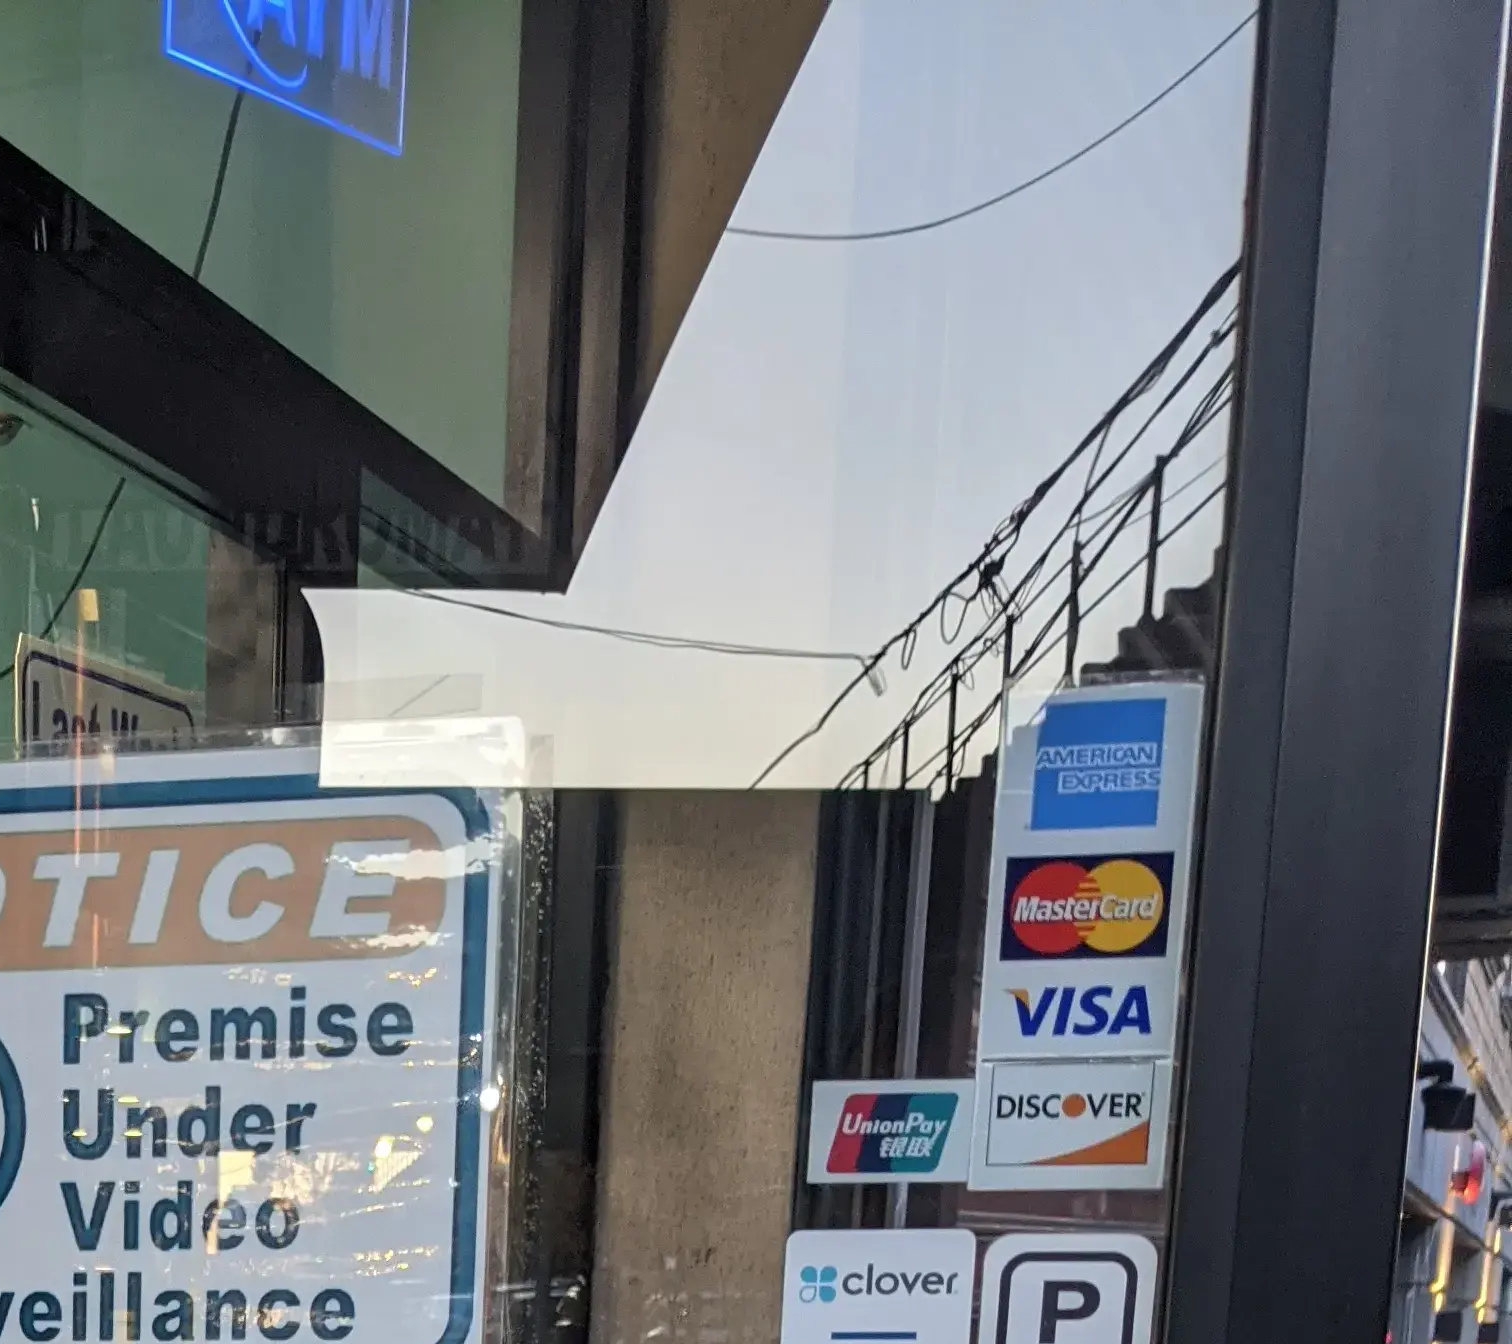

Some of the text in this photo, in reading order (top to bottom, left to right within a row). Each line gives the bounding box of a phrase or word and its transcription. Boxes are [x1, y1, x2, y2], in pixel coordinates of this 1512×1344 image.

[1036, 744, 1155, 766] AMERICAN
[1059, 769, 1161, 792] EXPRESS
[1013, 892, 1157, 923] MasterCard
[61, 986, 414, 1066] Premise
[1004, 984, 1152, 1036] VISA
[996, 1093, 1143, 1120] DISCOVER
[61, 1087, 318, 1161] Under
[841, 1111, 947, 1143] UnionPay
[60, 1180, 300, 1254] Video
[842, 1263, 958, 1297] clover
